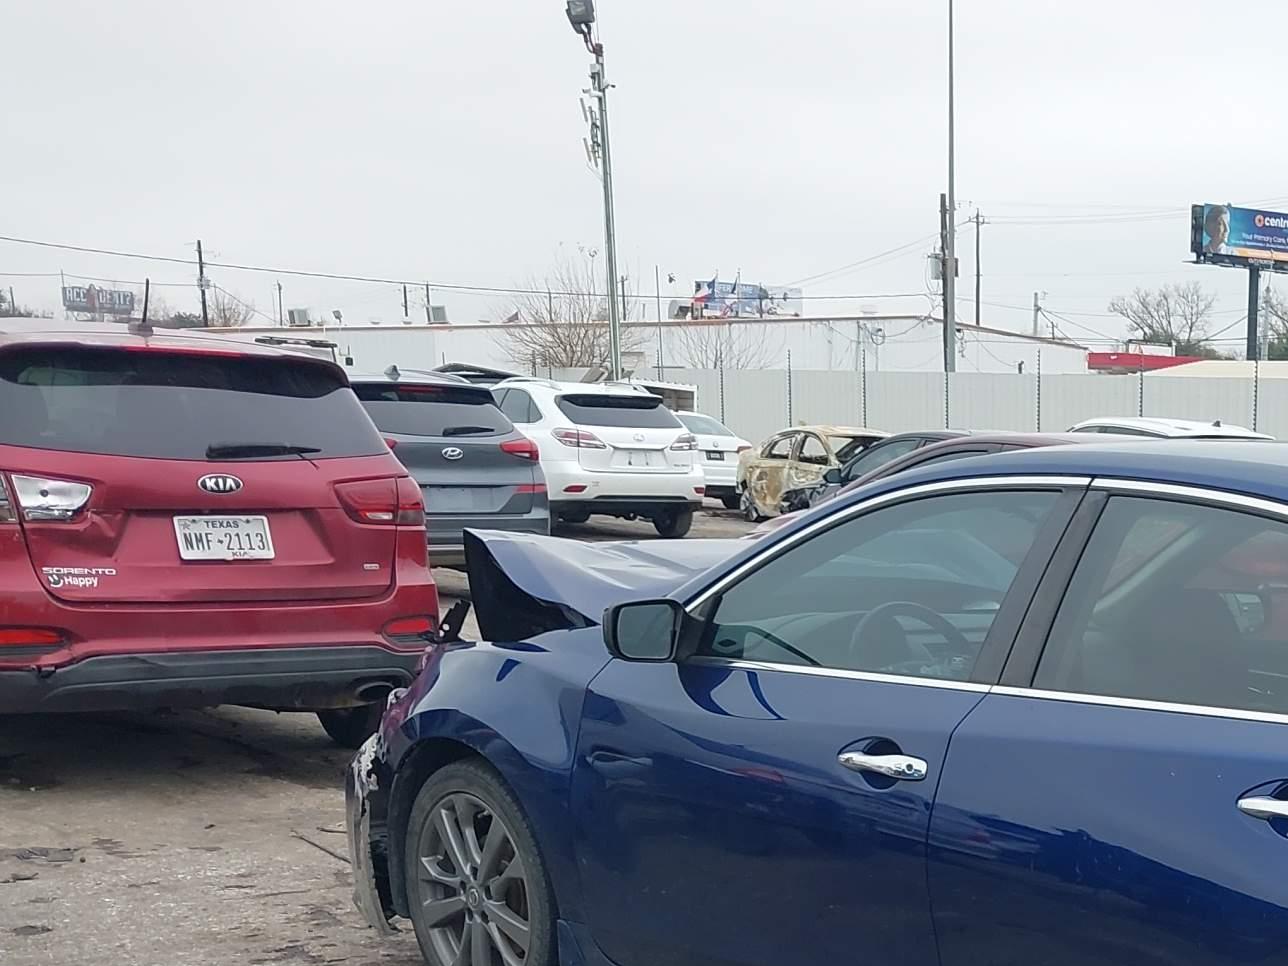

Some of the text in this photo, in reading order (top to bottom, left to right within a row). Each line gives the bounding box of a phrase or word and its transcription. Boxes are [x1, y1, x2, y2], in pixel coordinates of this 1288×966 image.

[204, 477, 237, 491] KIA
[203, 520, 240, 529] TEXAS
[42, 566, 117, 576] SORENTO
[64, 576, 98, 588] Happy
